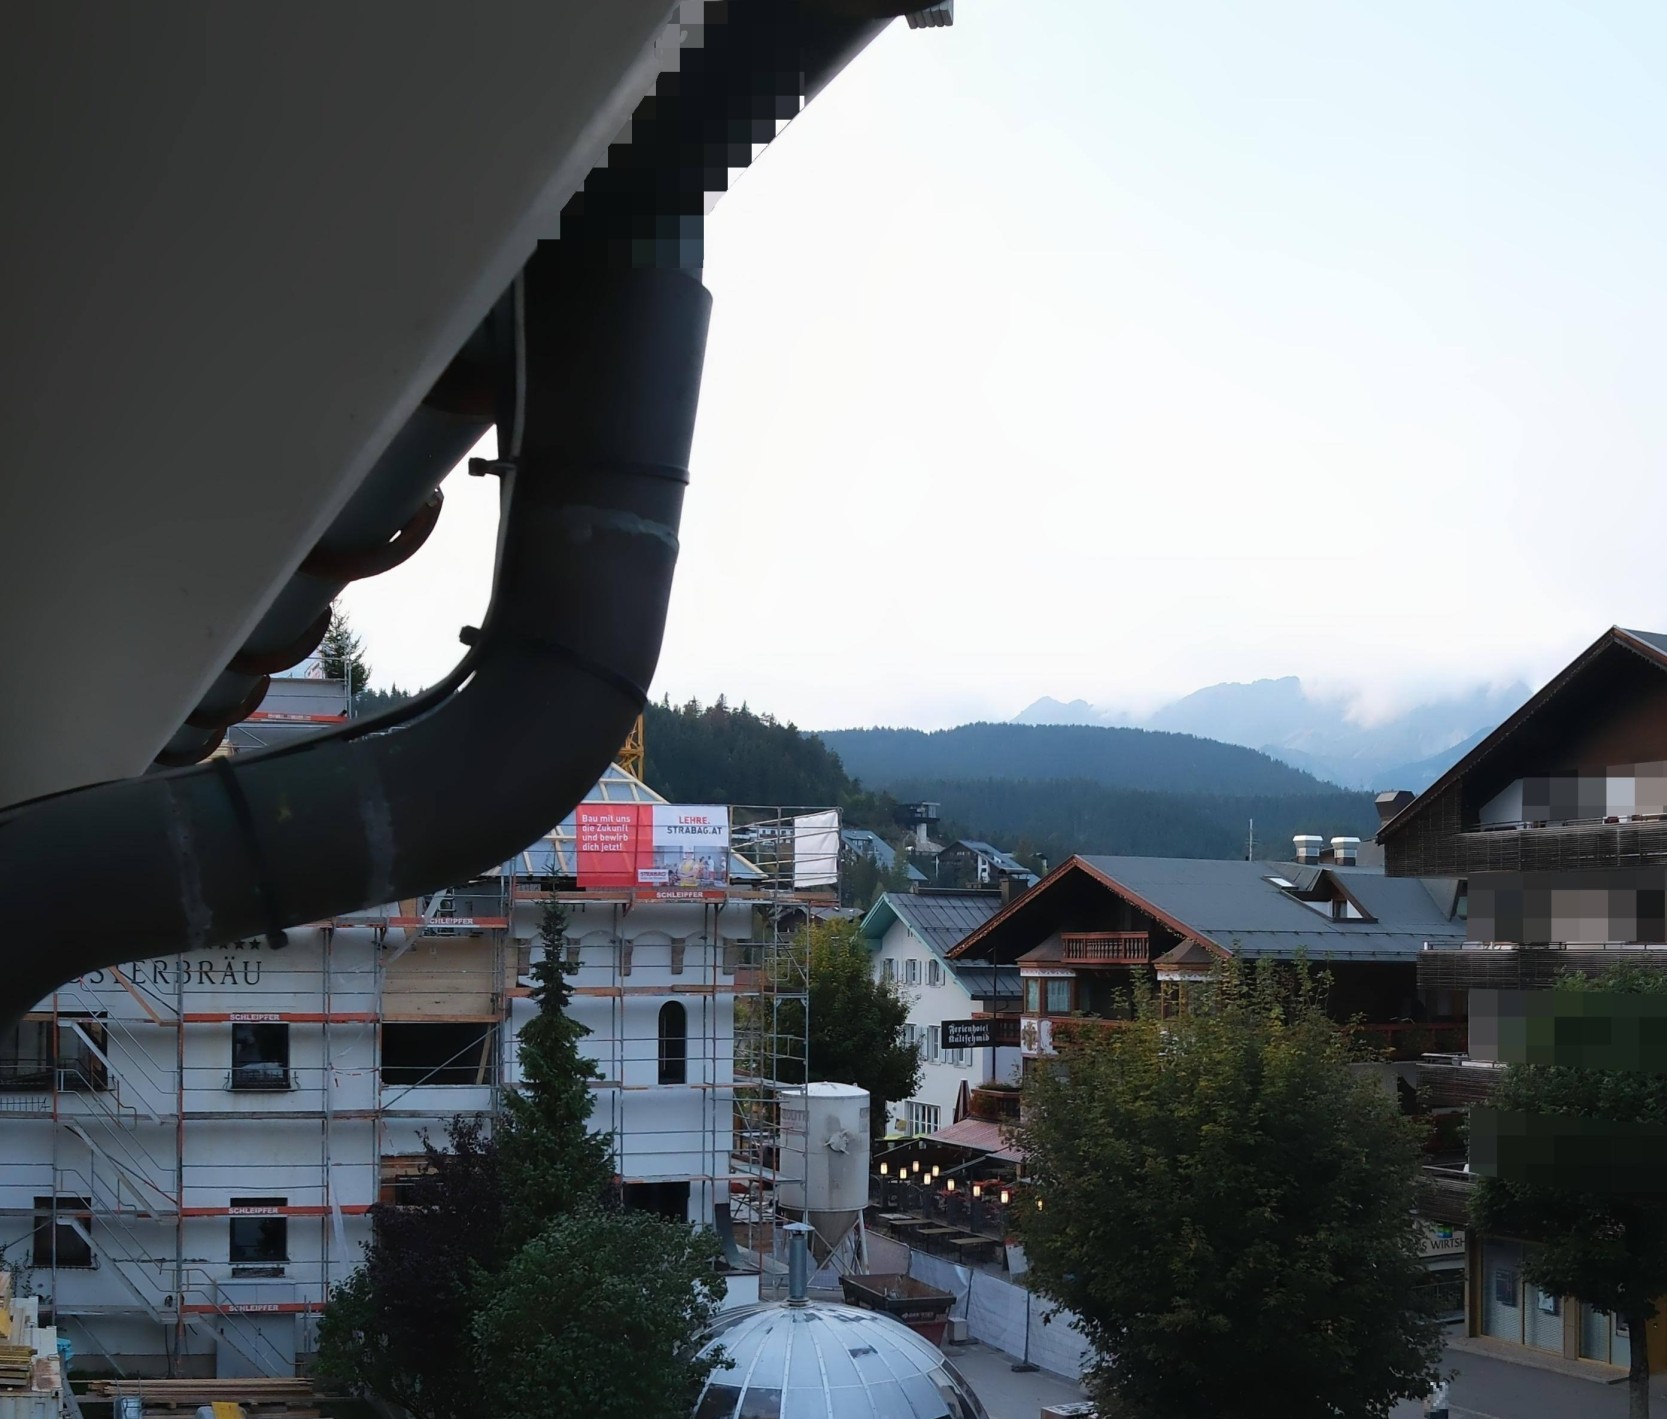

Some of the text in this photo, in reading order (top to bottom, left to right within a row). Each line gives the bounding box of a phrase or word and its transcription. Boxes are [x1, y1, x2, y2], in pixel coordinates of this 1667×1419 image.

[582, 814, 631, 823] Bau mit uns
[678, 815, 711, 825] LEHRE.
[582, 823, 628, 832] die Zukunft
[666, 825, 723, 835] STRABAG.AT
[582, 832, 629, 842] und bewirb
[582, 842, 623, 852] dich jetzt!
[656, 891, 704, 899] SCHLEIPFER
[426, 917, 474, 925] CHLEIPFER
[229, 1013, 281, 1021] SCHLEIPFER
[228, 1304, 279, 1312] SCHLEIPFER
